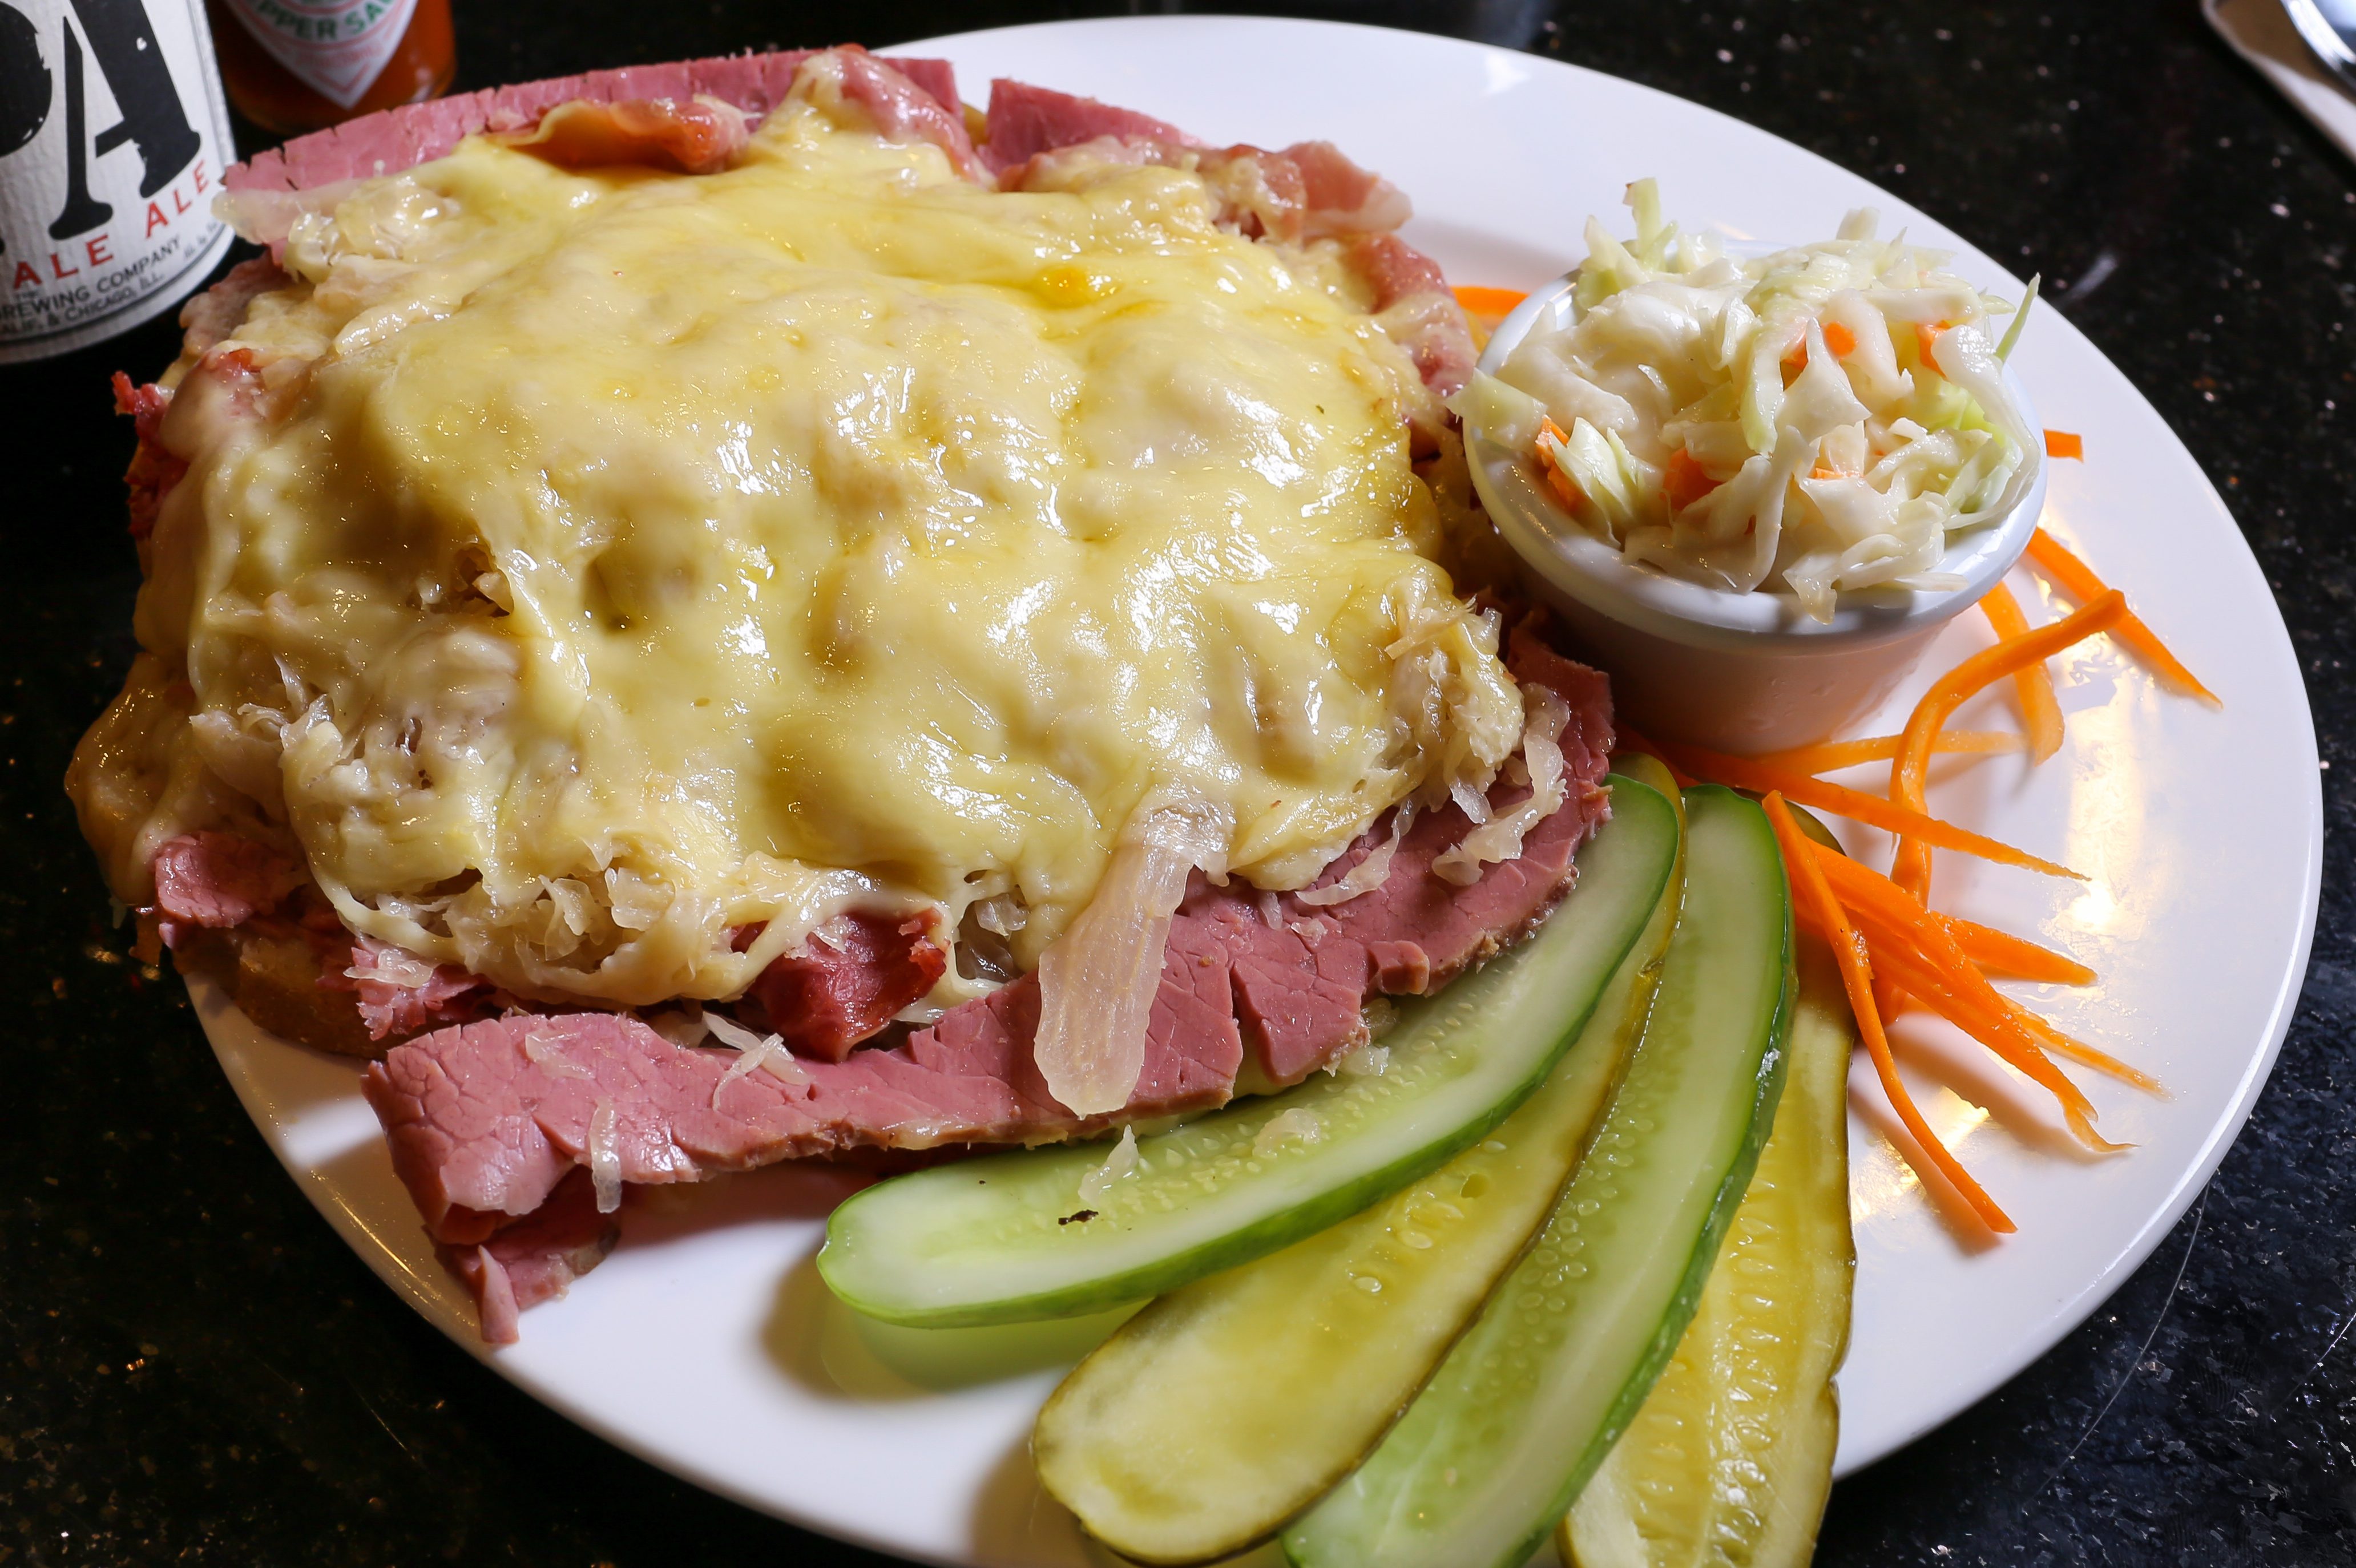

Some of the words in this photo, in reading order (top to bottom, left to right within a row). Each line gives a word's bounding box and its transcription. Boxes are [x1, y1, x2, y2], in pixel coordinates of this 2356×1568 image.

[345, 0, 393, 35] SA
[13, 234, 113, 289] ALE
[146, 159, 209, 239] ALE
[0, 286, 90, 320] REWING
[96, 235, 180, 293] COMPANY
